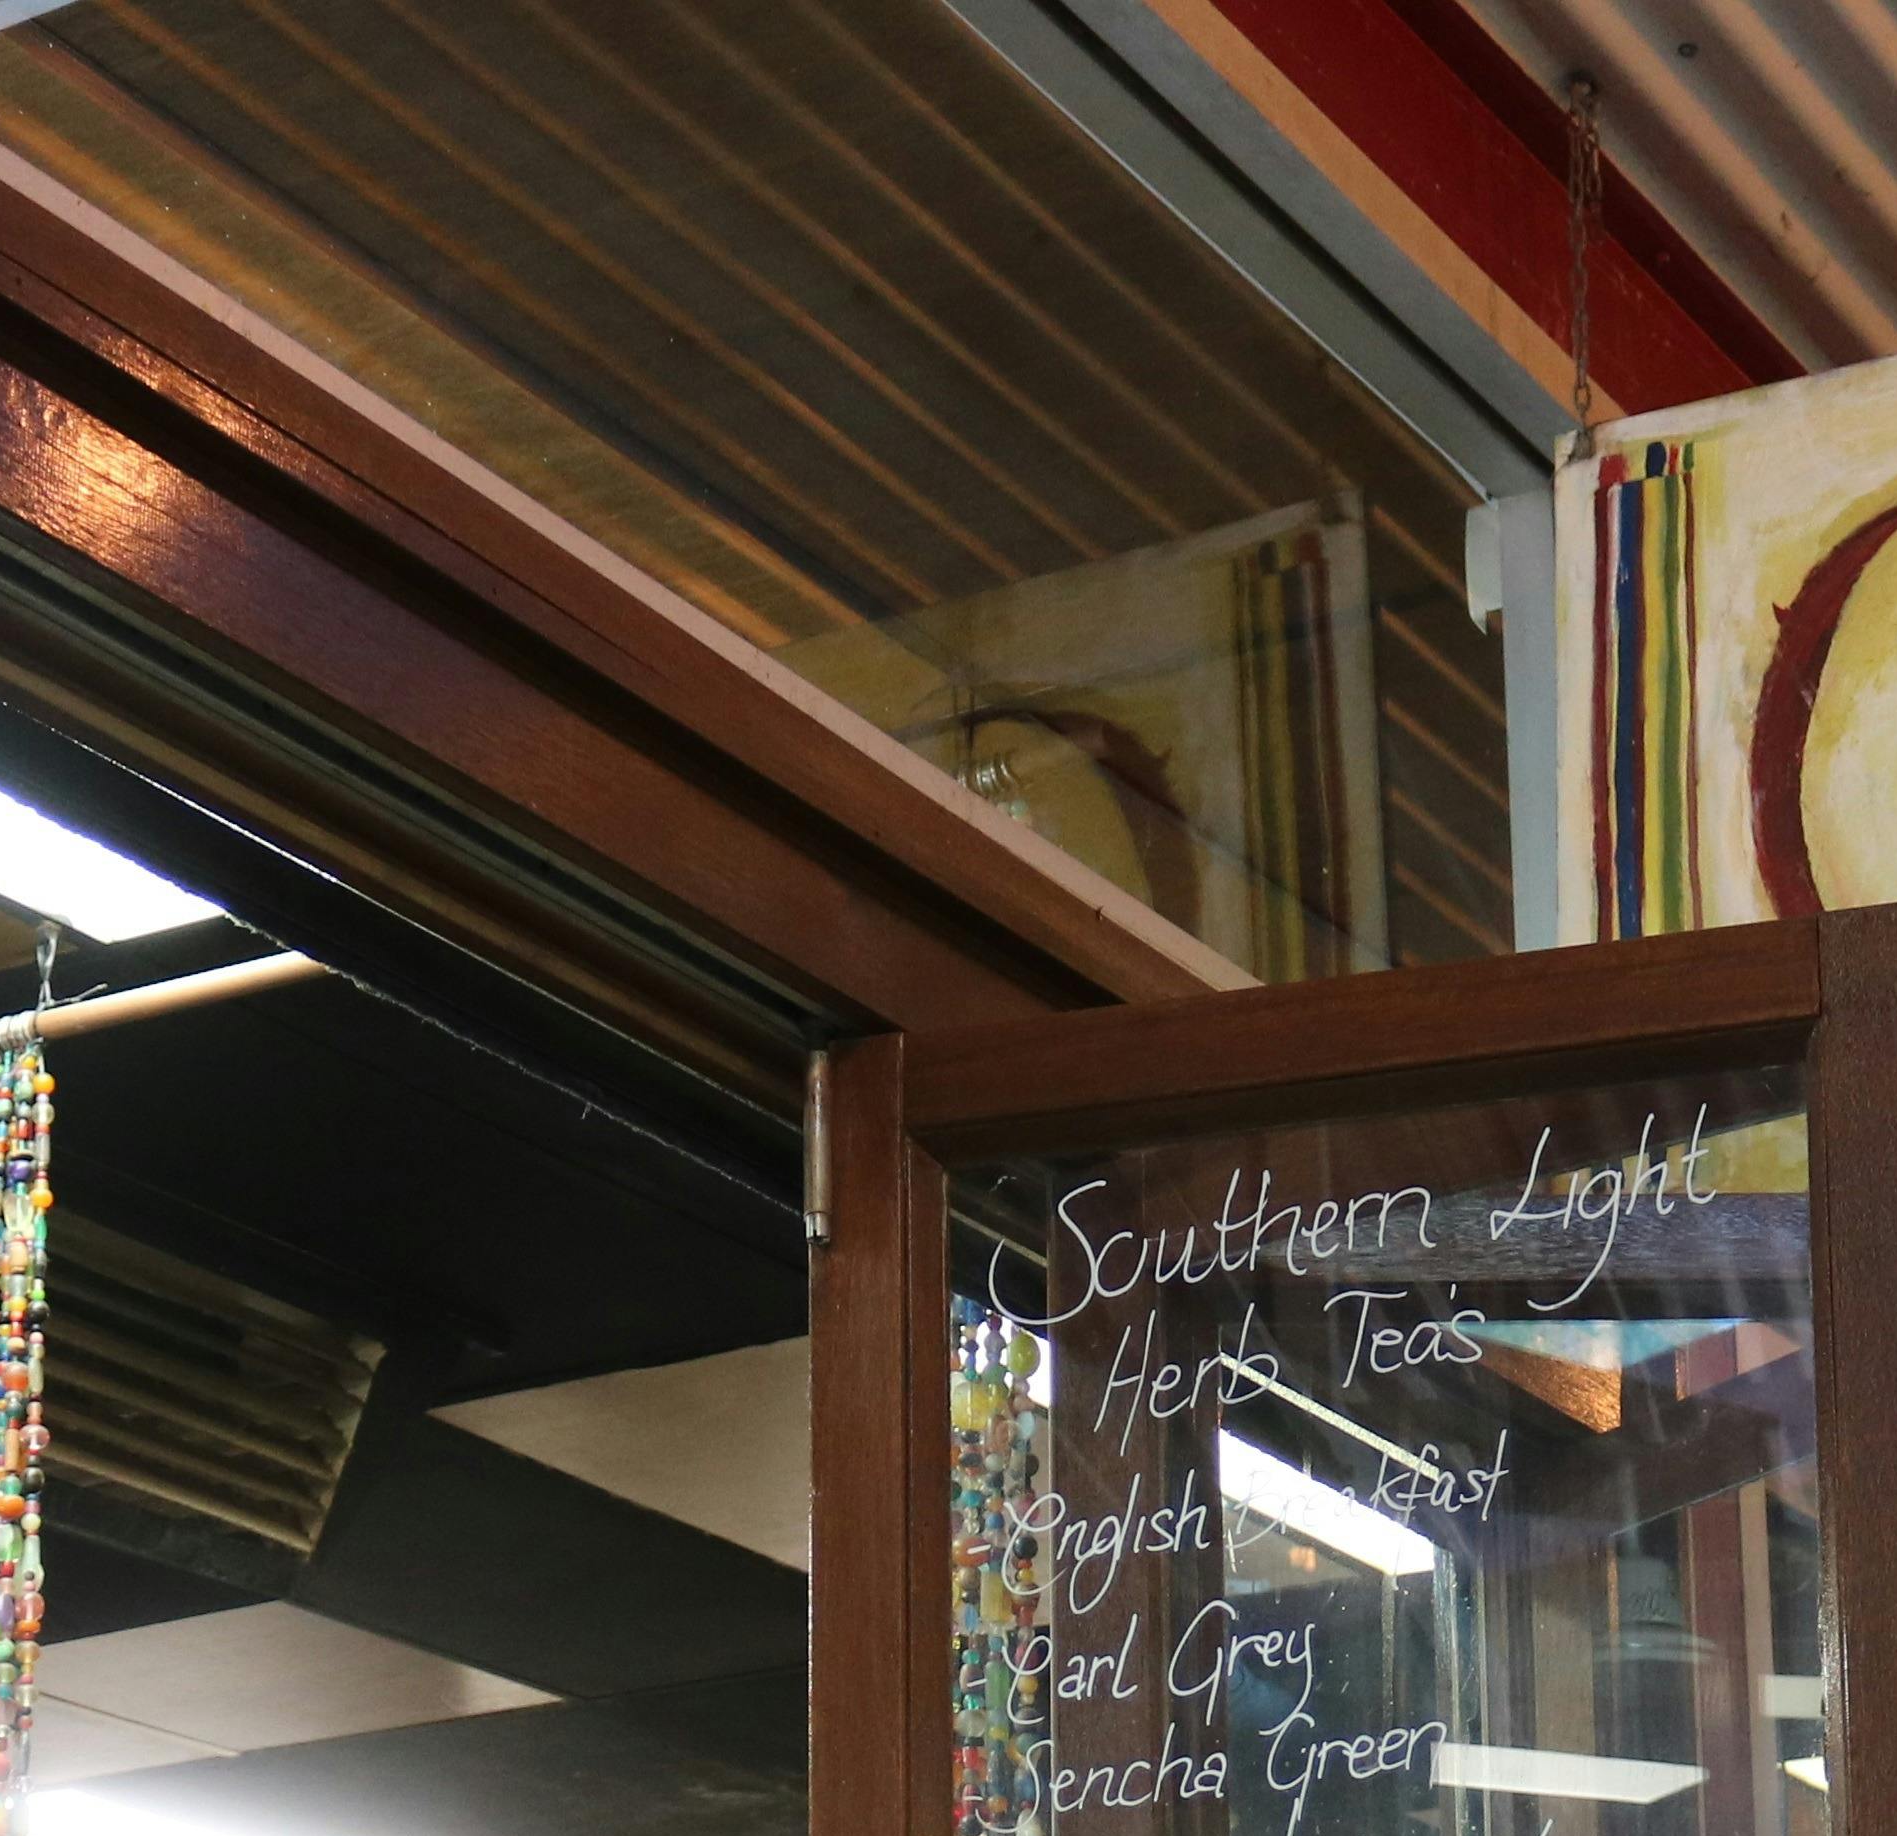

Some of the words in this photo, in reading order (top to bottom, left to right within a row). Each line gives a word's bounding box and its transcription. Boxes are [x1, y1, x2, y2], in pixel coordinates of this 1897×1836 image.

[988, 1168, 1436, 1326] Southern
[1490, 1104, 1717, 1311] Light
[1094, 1304, 1279, 1457] Herb
[1324, 1282, 1487, 1389] Tea's
[1001, 1469, 1210, 1615] English
[1002, 1613, 1138, 1725] Earl
[1168, 1600, 1316, 1730] Grey
[975, 1722, 1228, 1833] Sencha
[1259, 1712, 1449, 1793] Green
